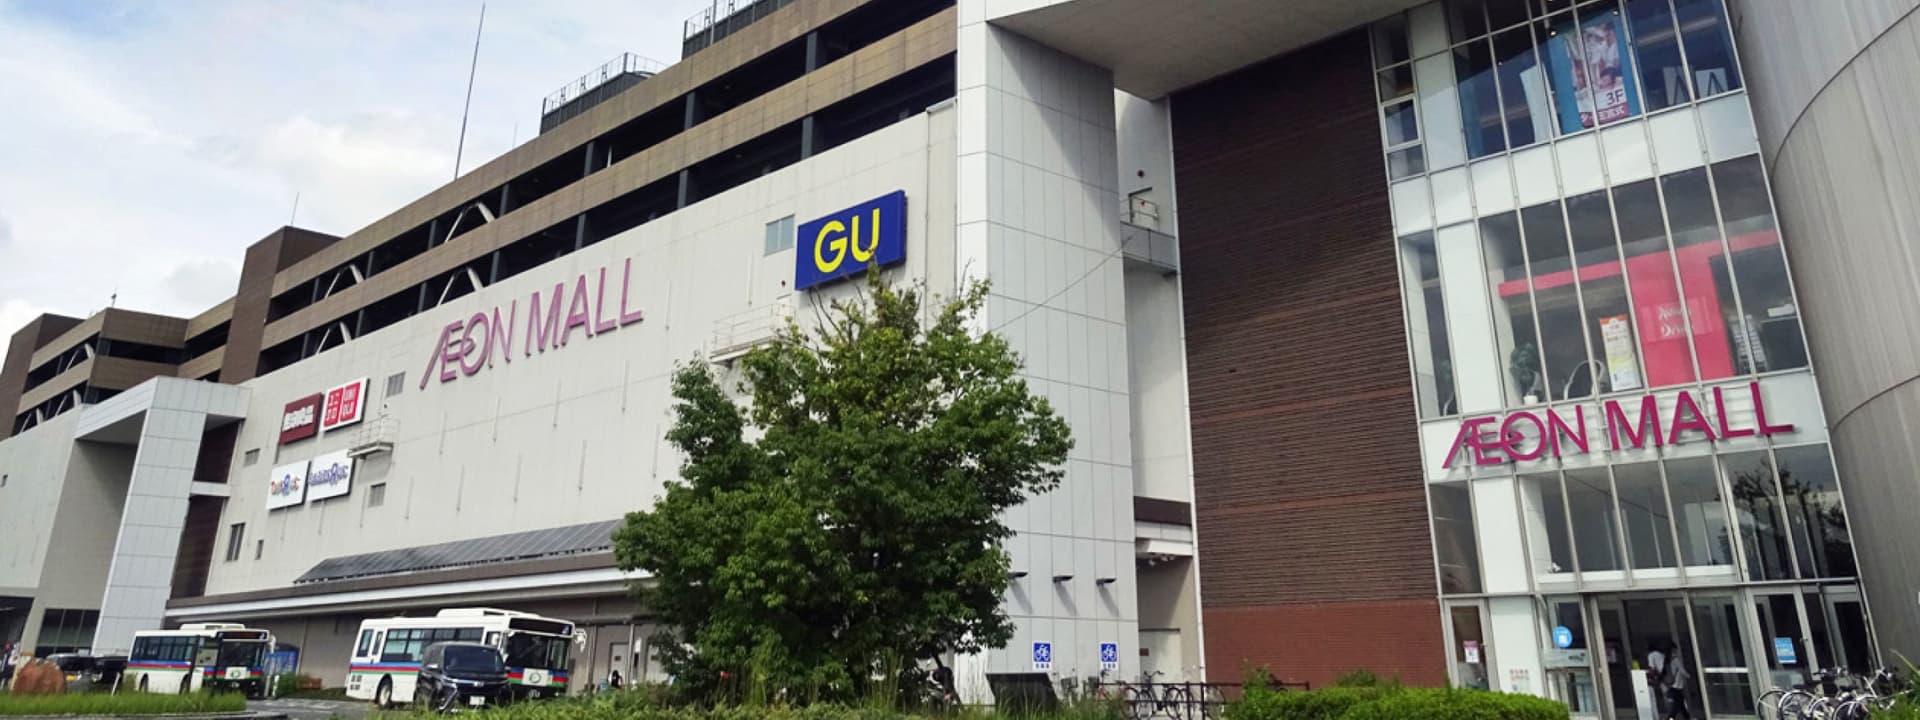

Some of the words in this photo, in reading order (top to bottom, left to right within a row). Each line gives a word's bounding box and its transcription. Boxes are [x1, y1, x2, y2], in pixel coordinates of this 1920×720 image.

[1606, 88, 1624, 105] 3F
[814, 208, 880, 273] GU
[524, 257, 643, 356] MALL
[1605, 381, 1794, 451] MALL
